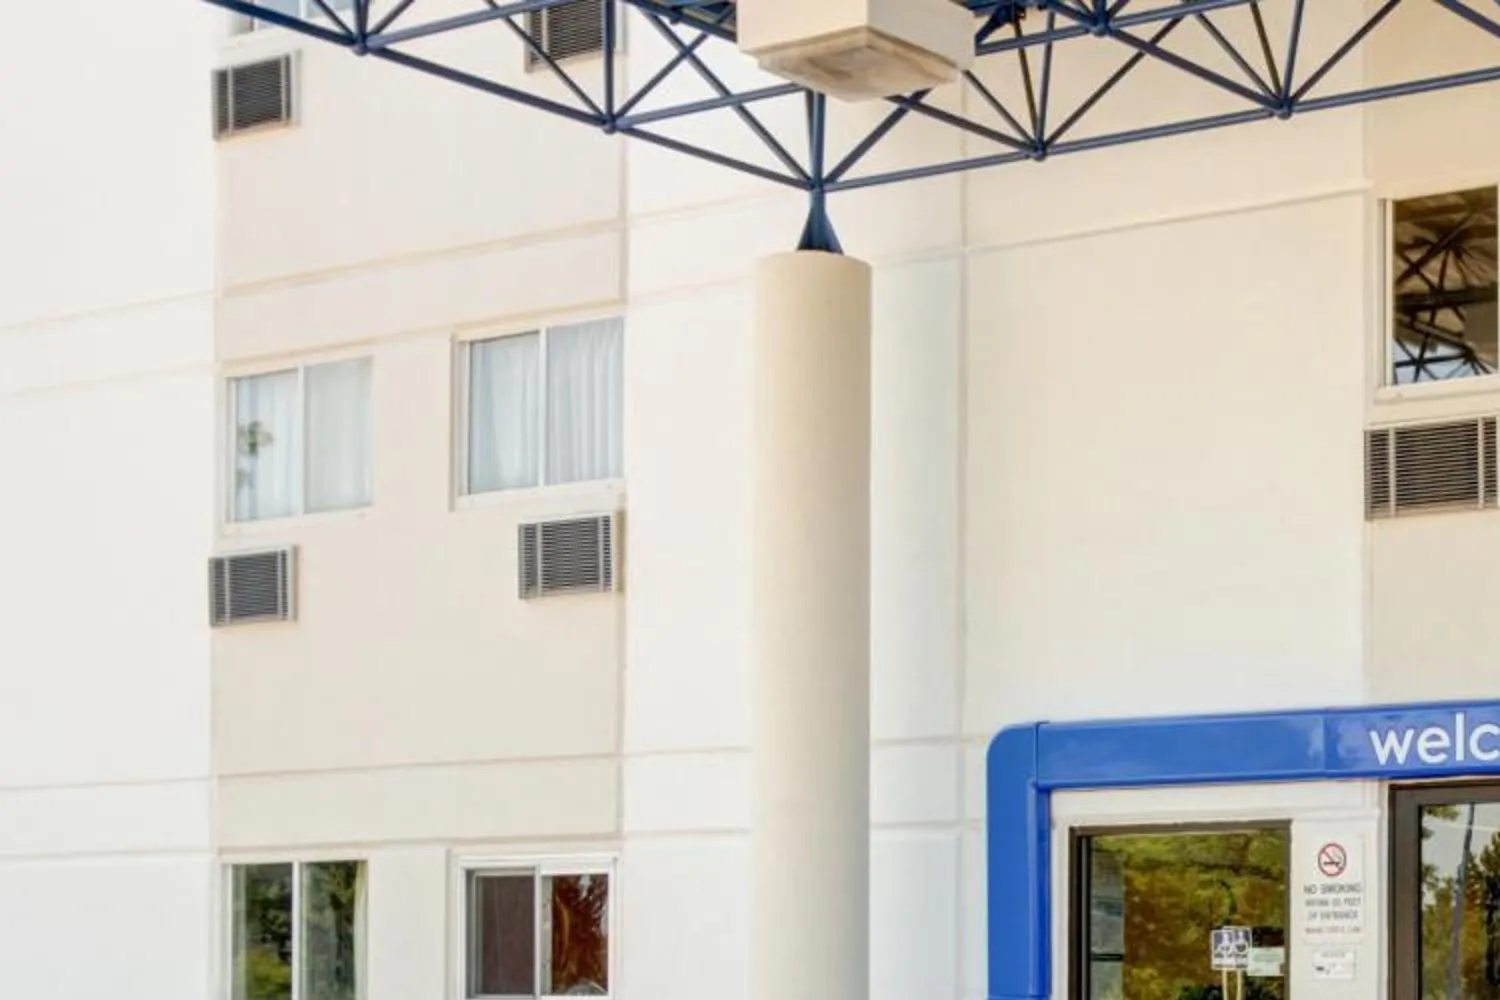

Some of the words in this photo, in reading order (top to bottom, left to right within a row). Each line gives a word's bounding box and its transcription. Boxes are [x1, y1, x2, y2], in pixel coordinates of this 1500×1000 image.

[1303, 884, 1318, 895] NO
[1320, 882, 1362, 895] SMOKING
[1320, 909, 1359, 921] ENTRANCE
